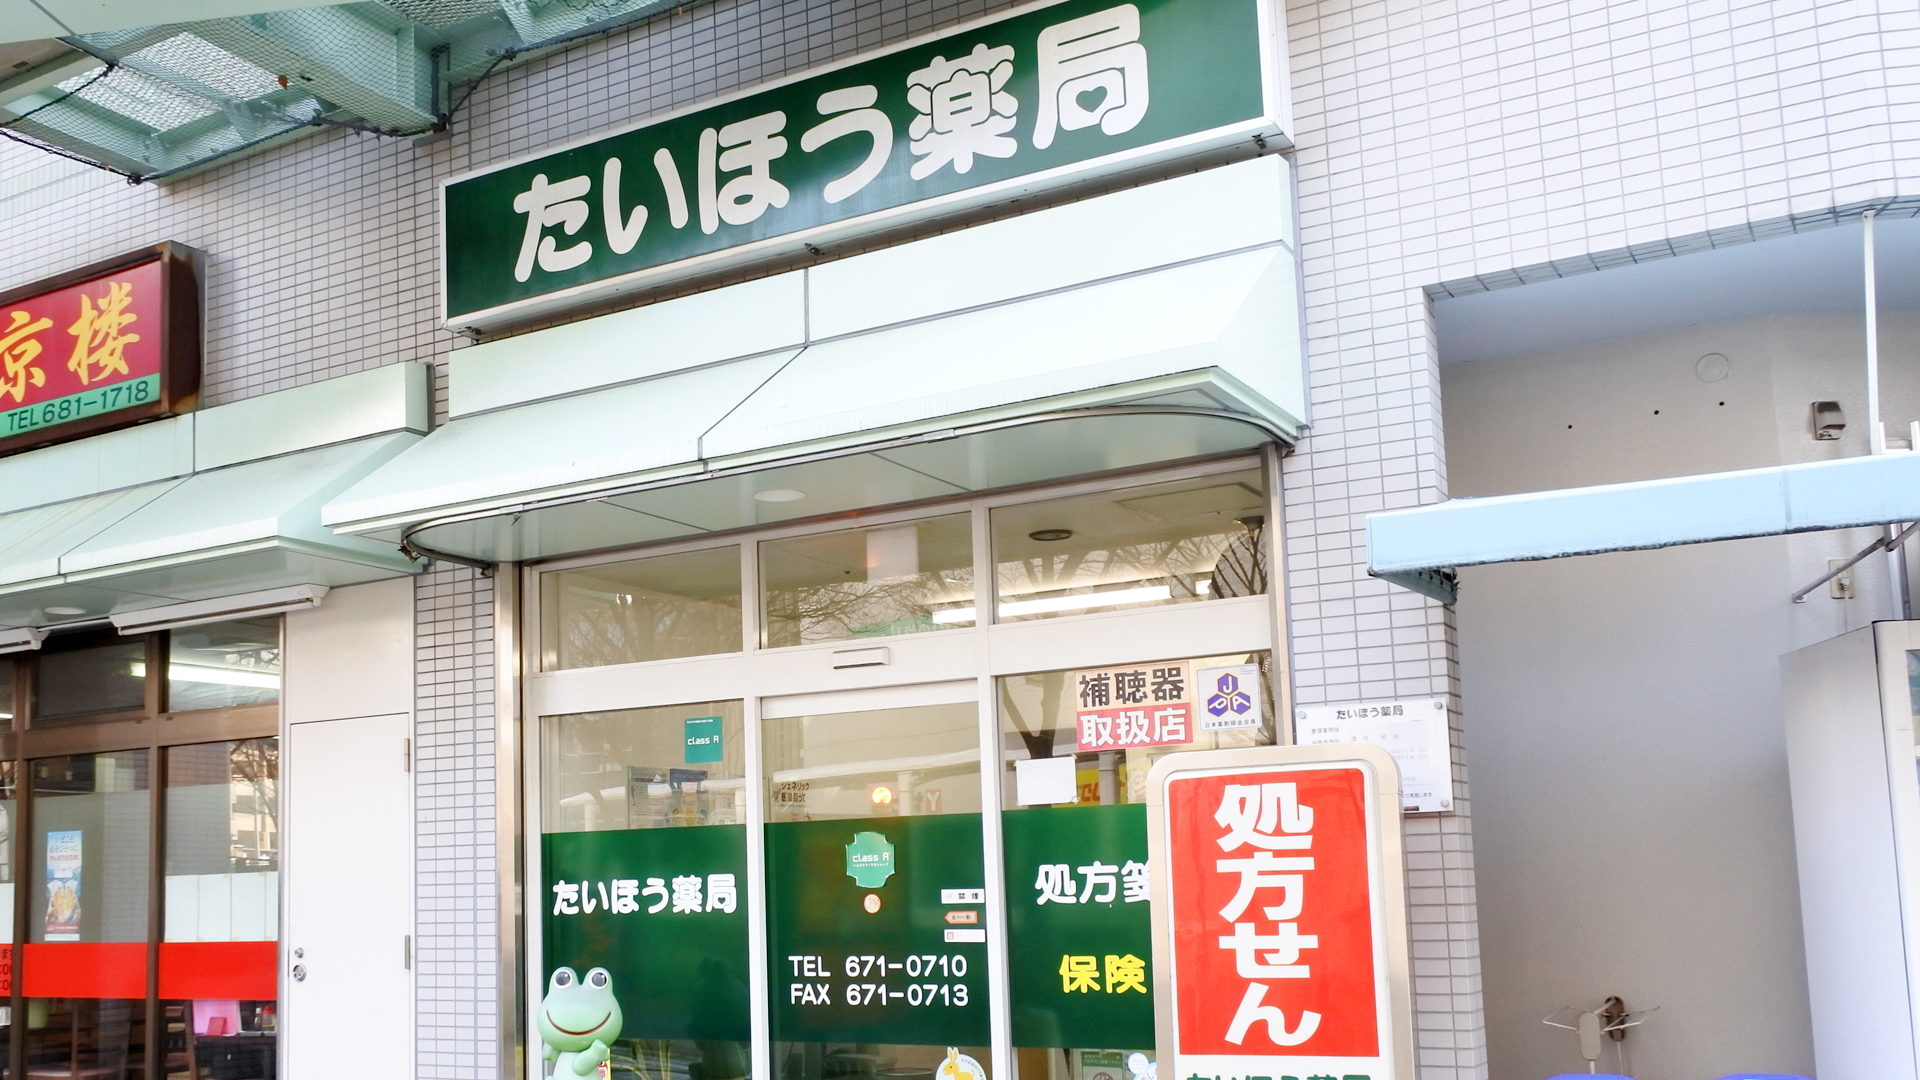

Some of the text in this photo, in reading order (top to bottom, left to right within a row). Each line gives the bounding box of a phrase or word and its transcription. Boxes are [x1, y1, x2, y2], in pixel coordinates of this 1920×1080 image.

[512, 2, 1150, 282] たいほう薬局
[7, 380, 149, 431] TEL 681-1718
[1079, 667, 1184, 708] 補聴器
[1080, 707, 1187, 747] 取扱店
[1336, 705, 1404, 720] たいほう薬局
[687, 734, 719, 745] class A
[781, 781, 810, 791] ジェネリック
[852, 851, 890, 863] class A
[552, 873, 737, 916] たいほう薬局
[1213, 782, 1322, 1047] 処方せん
[788, 955, 967, 977] TEL 671-0710
[1059, 953, 1147, 994] 保険
[791, 983, 969, 1006] FAX 671-0713
